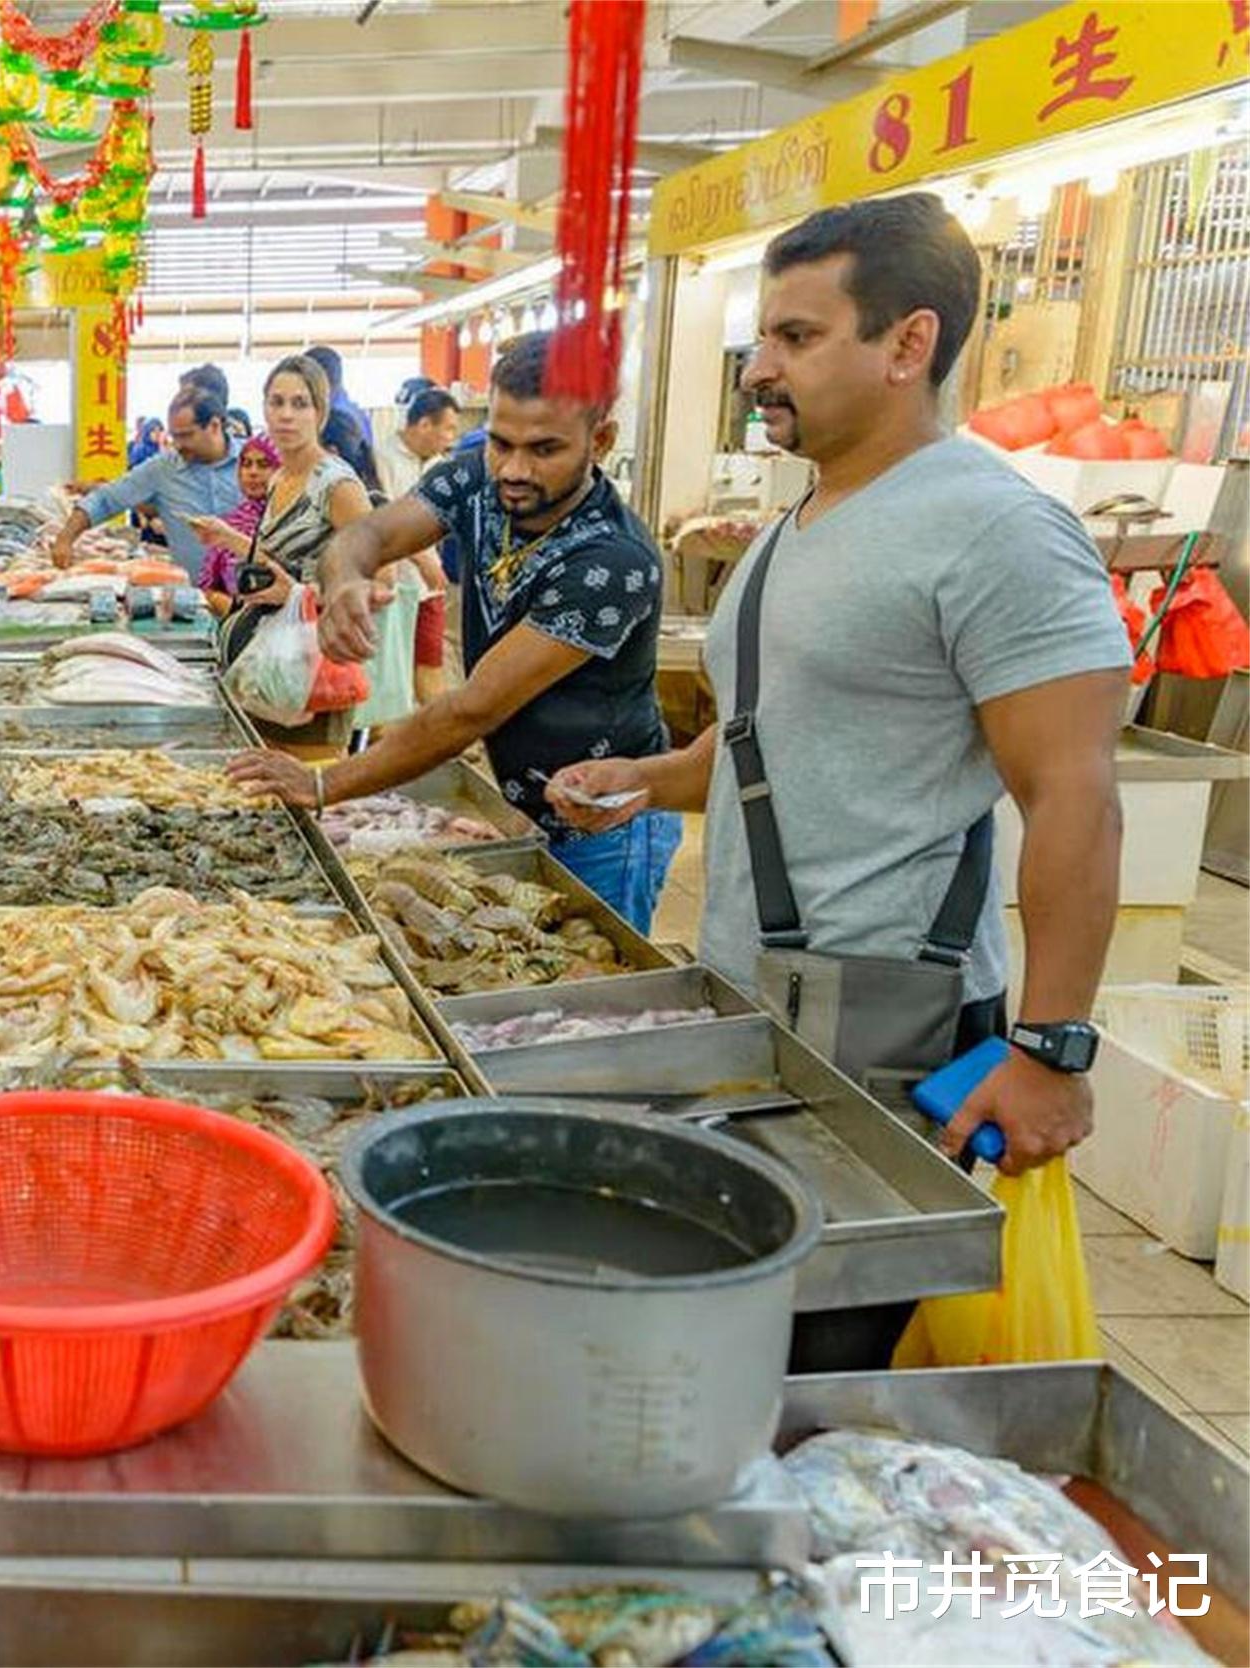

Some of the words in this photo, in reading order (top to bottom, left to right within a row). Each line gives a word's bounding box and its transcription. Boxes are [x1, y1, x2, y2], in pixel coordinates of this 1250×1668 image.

[868, 65, 977, 173] 81
[1036, 11, 1136, 122] 生
[83, 323, 121, 483] 81生
